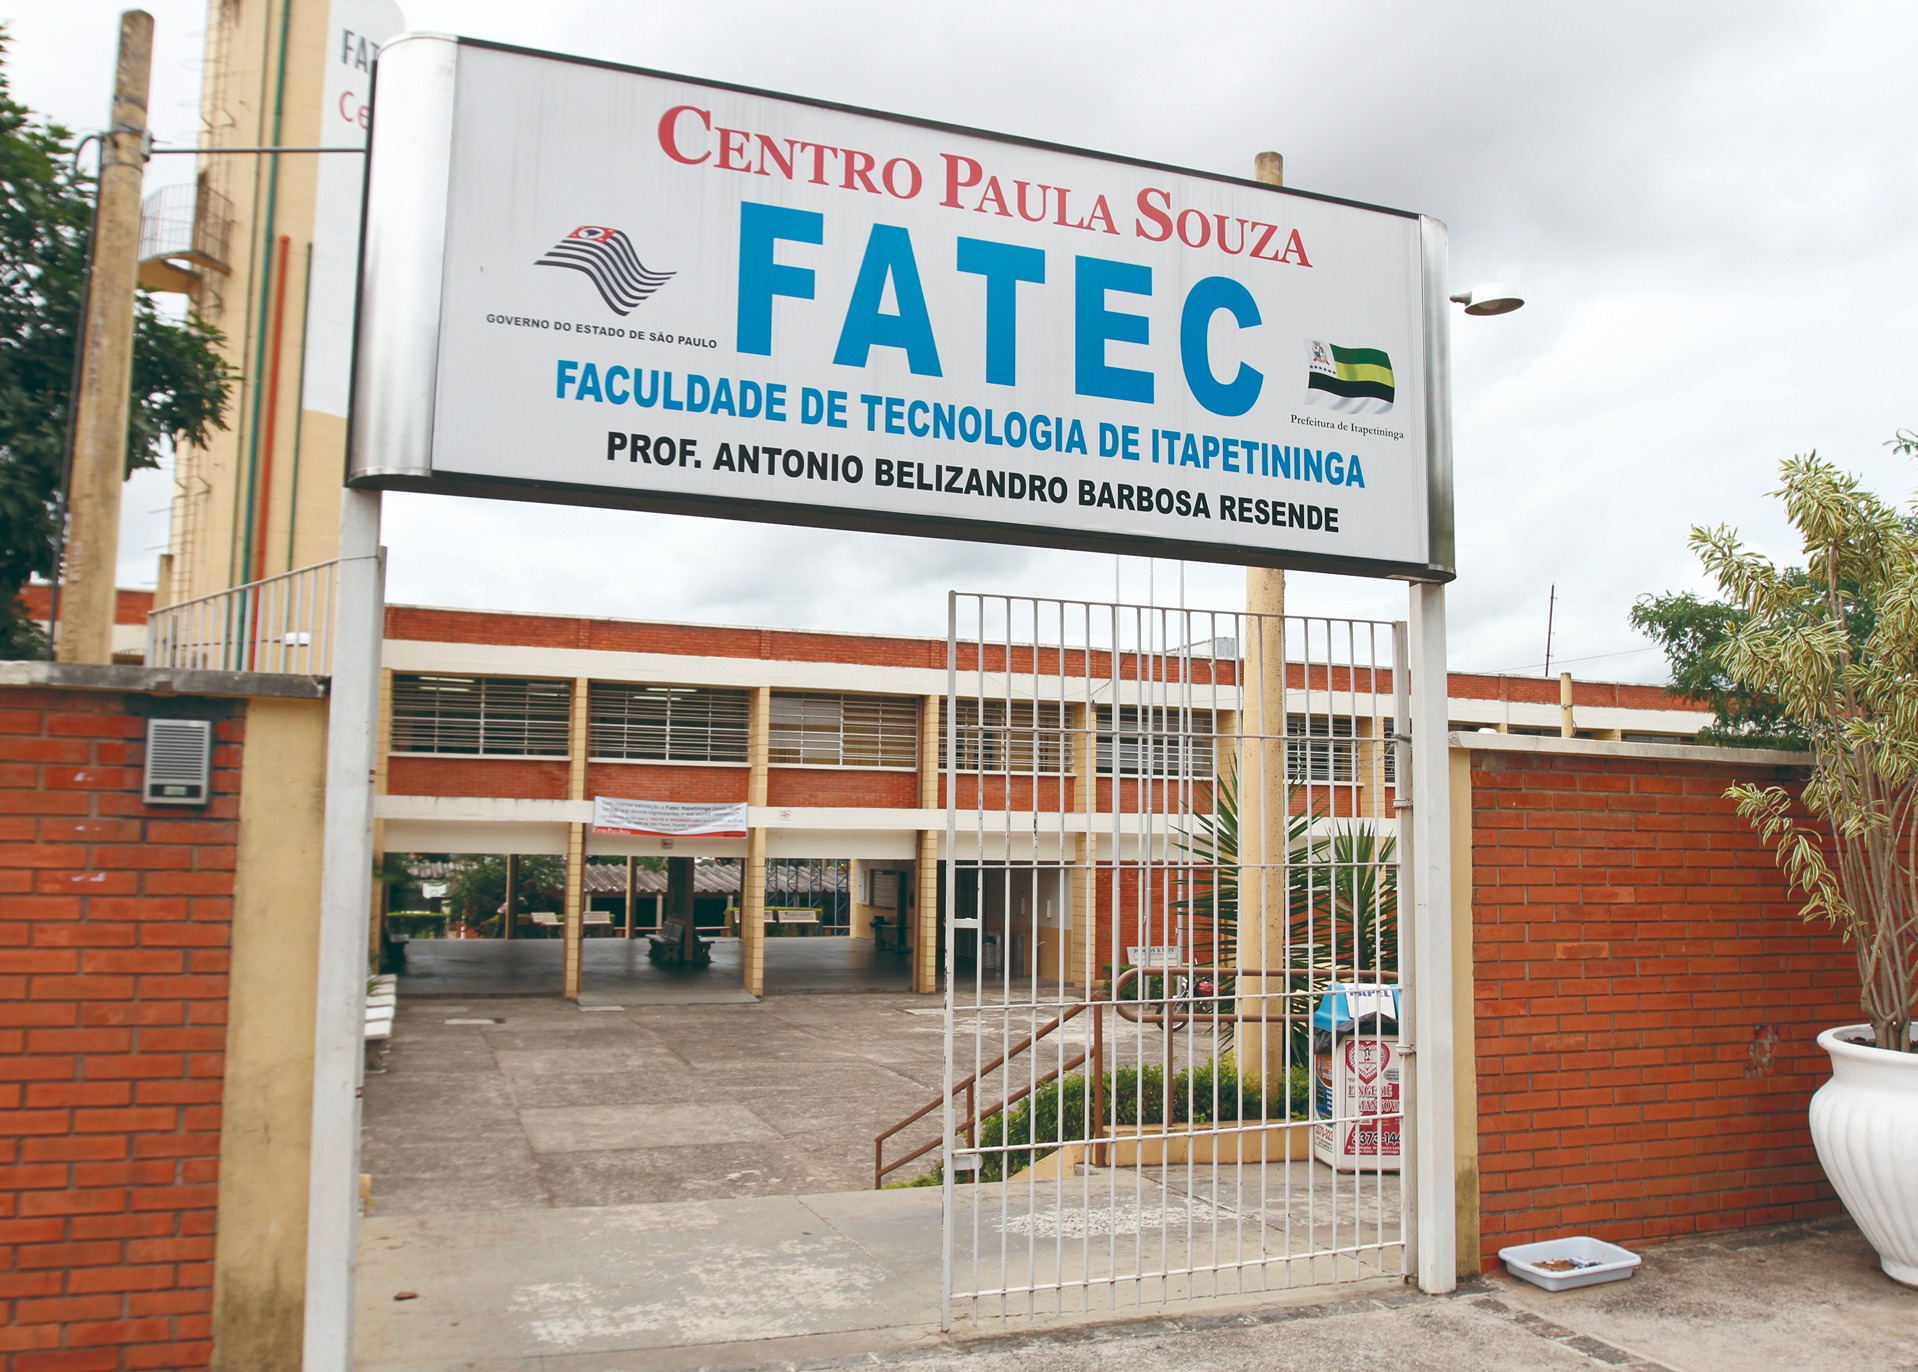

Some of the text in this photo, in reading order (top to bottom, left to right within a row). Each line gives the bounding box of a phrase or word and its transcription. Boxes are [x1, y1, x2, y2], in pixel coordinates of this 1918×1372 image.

[657, 105, 1312, 269] CENTRO PAULA SOUZA
[486, 313, 718, 349] GOVERNO DO ESTADO DE SÃO PAULO
[735, 200, 1265, 418] FATEC
[555, 358, 1366, 489] FACULDADE DE TECNOLOGIA DE ITAPETININGA
[1290, 414, 1405, 441] Prefeitura de Itapetininga
[607, 431, 1339, 533] PROF. ANTONIO BELIZANDRO BARBOSA RESENDE
[1348, 1084, 1392, 1097] LNGEIE
